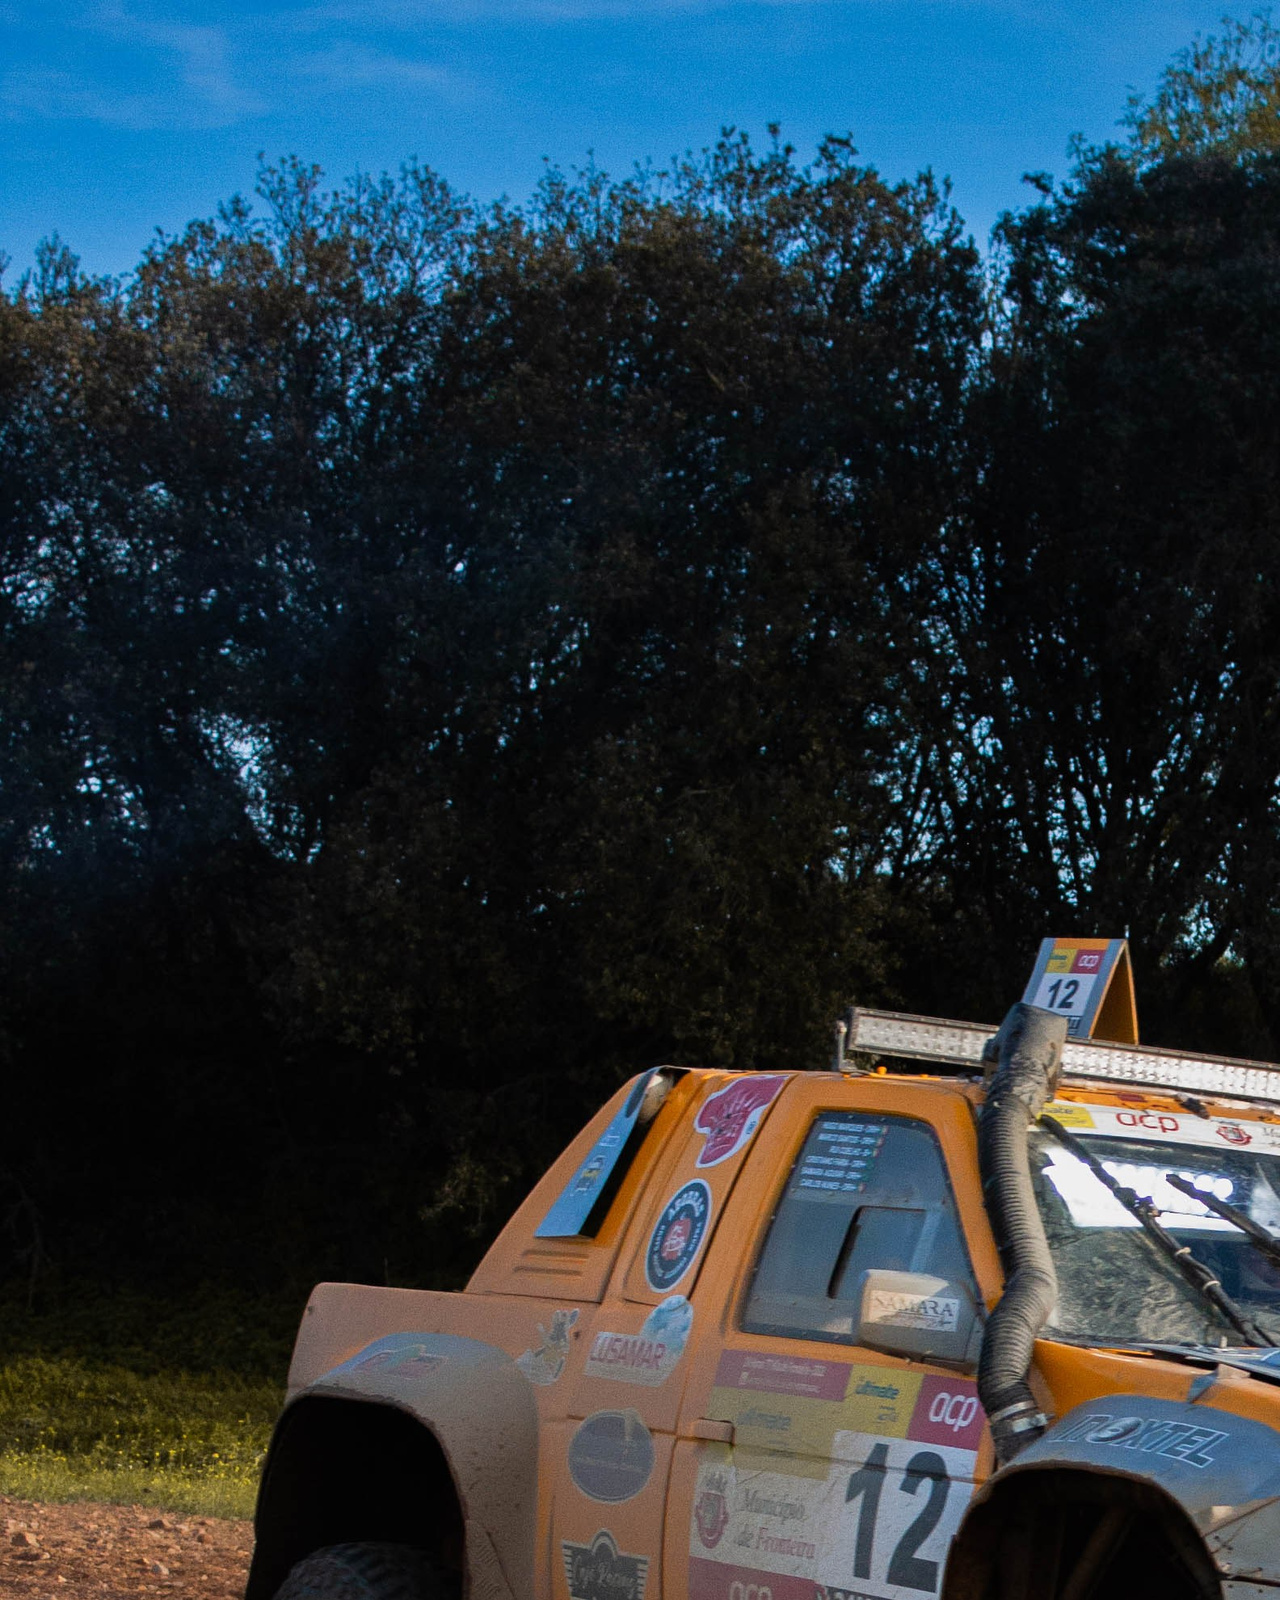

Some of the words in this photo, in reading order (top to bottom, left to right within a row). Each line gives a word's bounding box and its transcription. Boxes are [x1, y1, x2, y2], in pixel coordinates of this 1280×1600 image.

[1078, 955, 1099, 969] acp
[1048, 979, 1080, 1010] 12
[1116, 1112, 1180, 1134] acp
[588, 1336, 667, 1371] LUSAMAR
[928, 1391, 979, 1432] acp
[845, 1442, 951, 1594] 12
